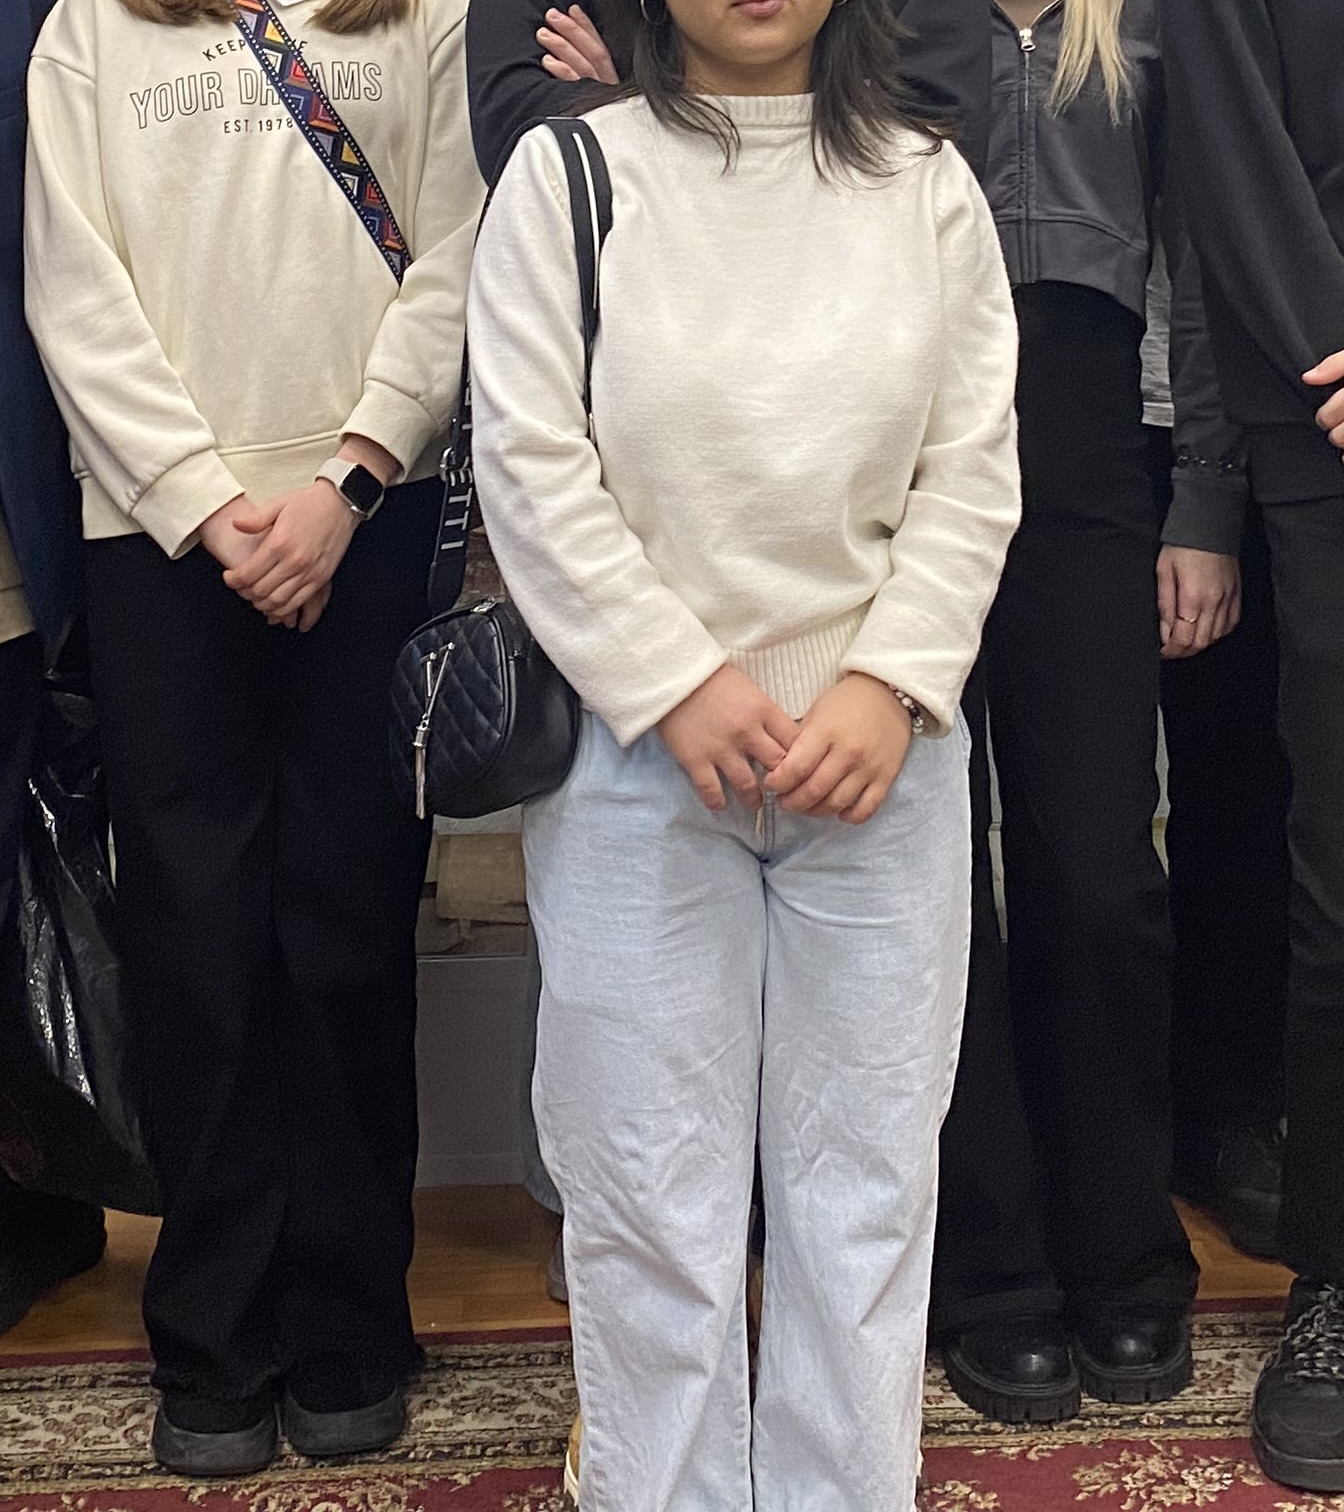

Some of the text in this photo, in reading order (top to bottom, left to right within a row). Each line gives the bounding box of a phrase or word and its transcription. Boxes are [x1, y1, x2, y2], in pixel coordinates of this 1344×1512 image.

[202, 39, 248, 61] KEEP
[130, 71, 224, 130] YOUR
[224, 117, 294, 134] EST. 1978
